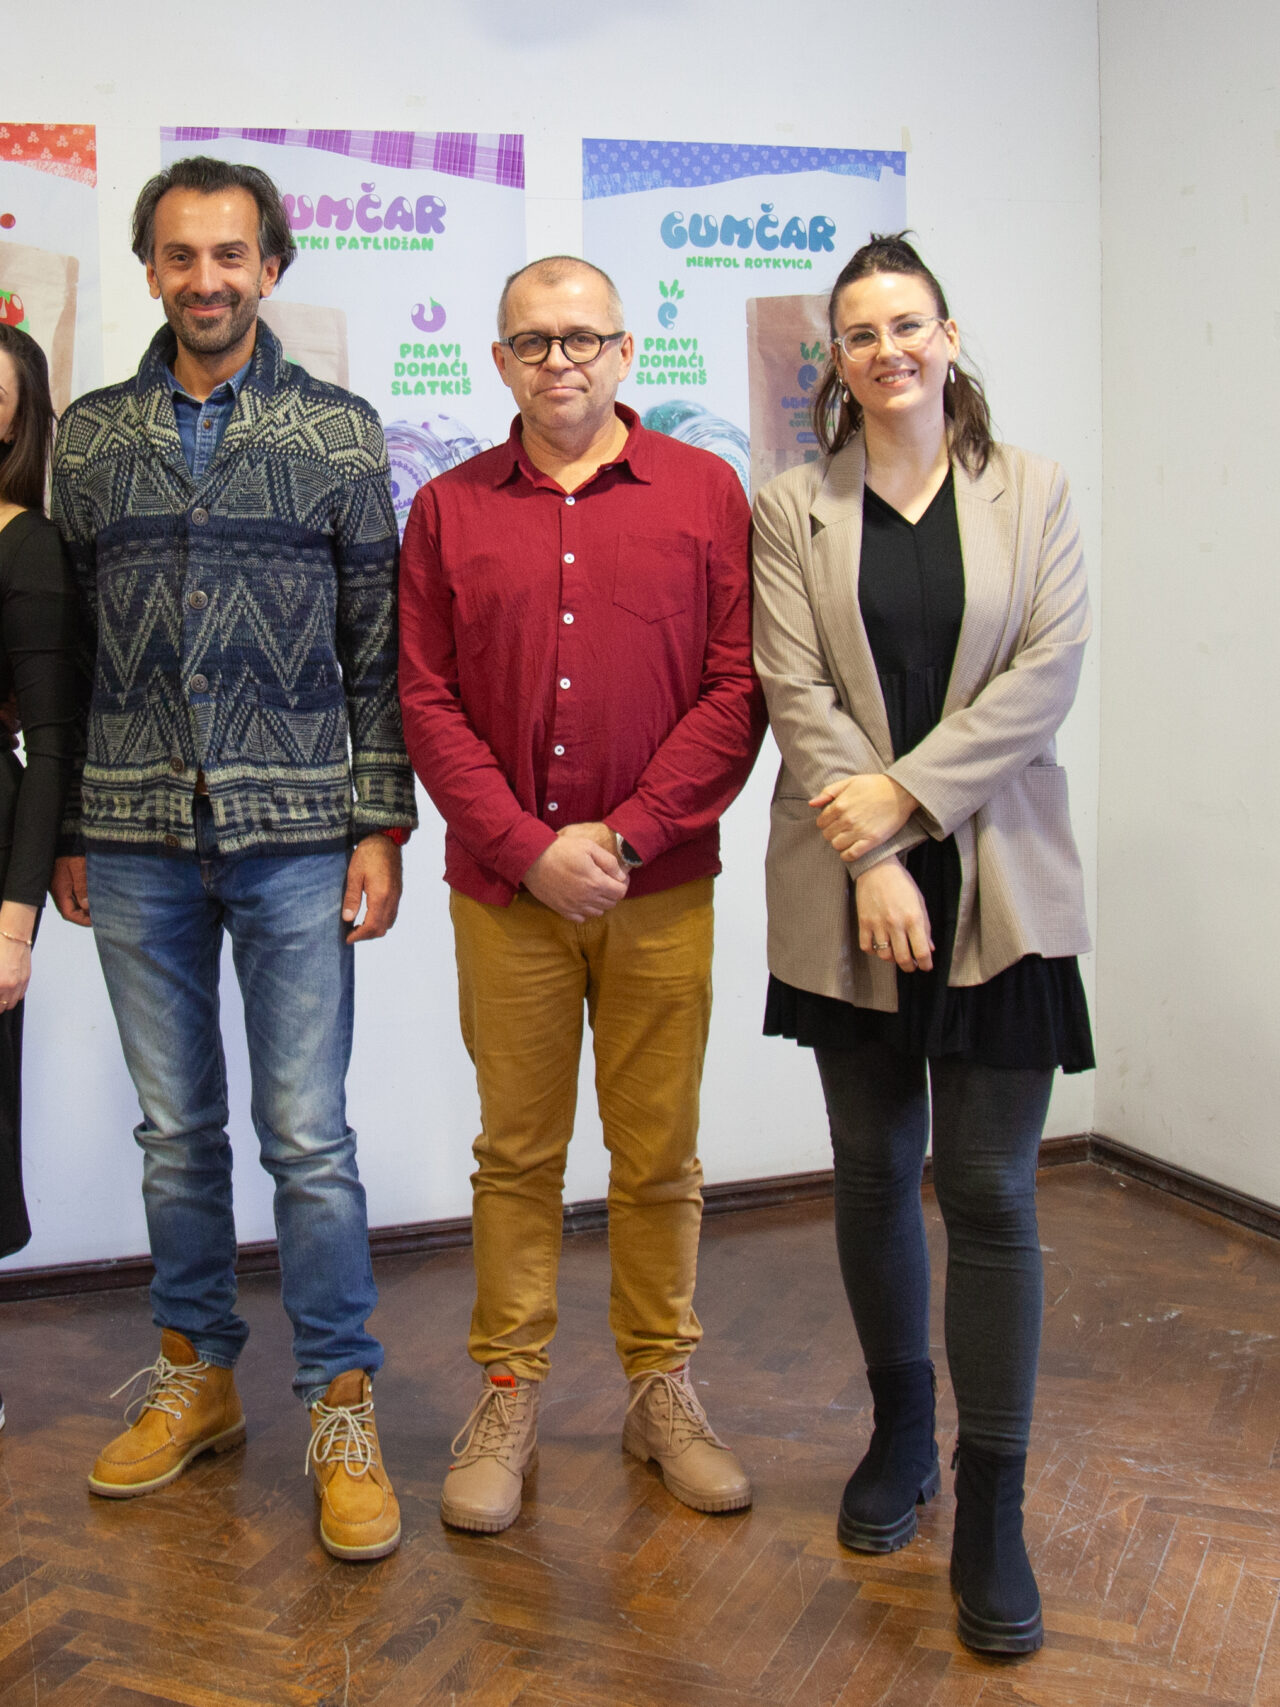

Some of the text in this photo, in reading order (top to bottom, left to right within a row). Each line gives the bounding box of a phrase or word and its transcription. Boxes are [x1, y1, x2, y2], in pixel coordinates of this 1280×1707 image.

[282, 182, 447, 235] UMČAR
[659, 202, 837, 253] GUMČAR
[291, 235, 330, 250] TKI
[686, 256, 813, 270] MENTOL ROTKVICA
[399, 342, 461, 359] PRAVI
[643, 336, 698, 351] PRAVI
[393, 358, 468, 377] DOMAĆI
[639, 352, 704, 368] DOMAĆI
[636, 369, 707, 385] SLATKIŠ
[391, 377, 471, 396] SLATKIŠ
